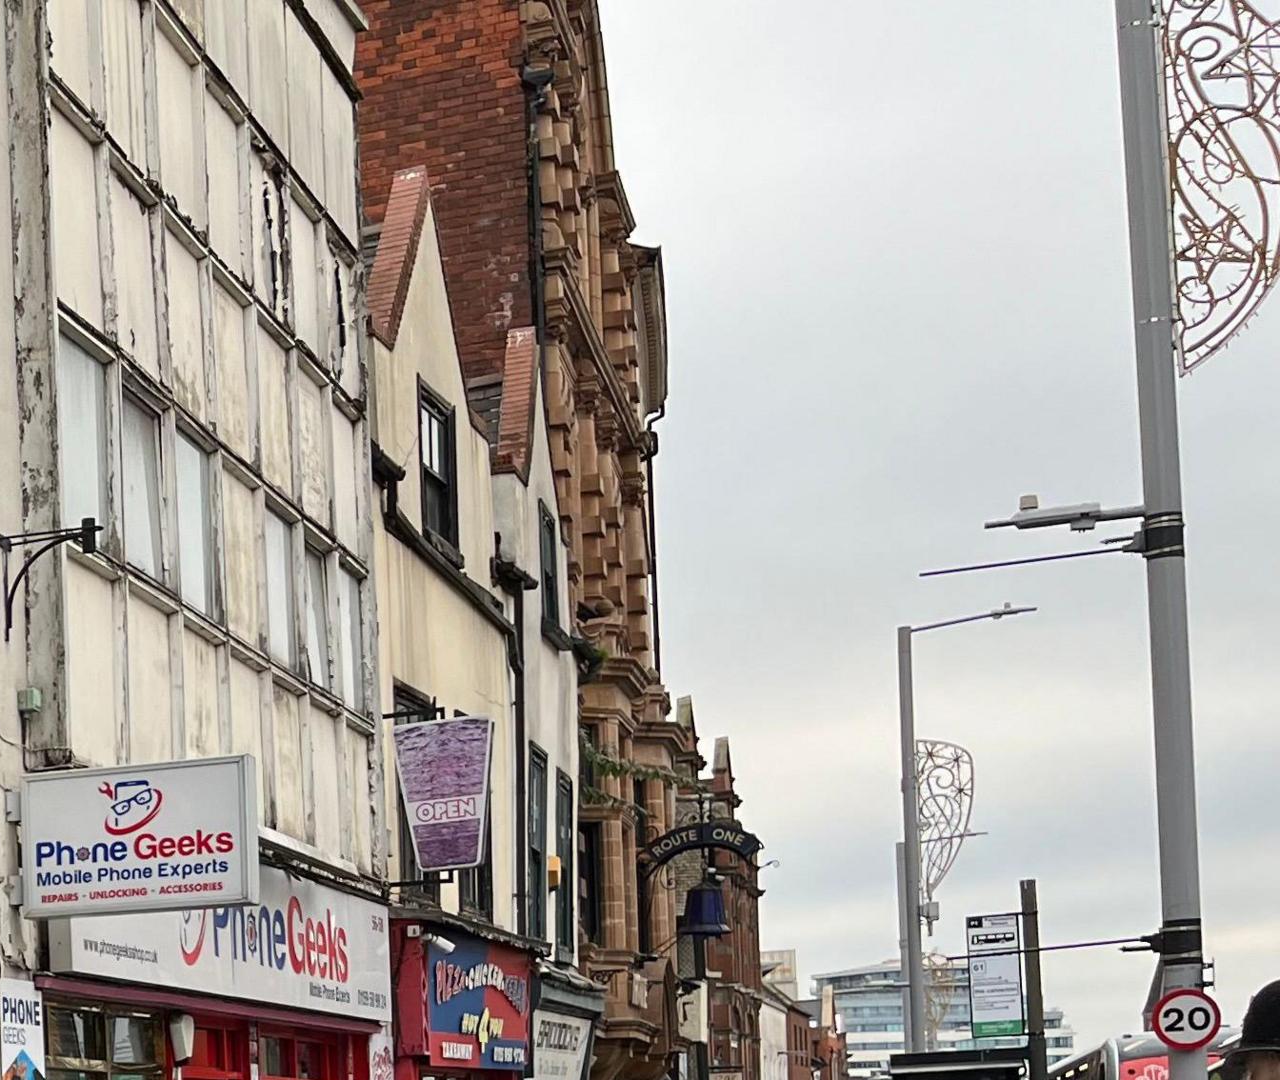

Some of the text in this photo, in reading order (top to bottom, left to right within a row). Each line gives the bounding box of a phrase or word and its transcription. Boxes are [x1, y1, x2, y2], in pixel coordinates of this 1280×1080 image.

[416, 798, 476, 822] OPEN
[133, 829, 234, 860] Geeks
[651, 828, 745, 857] ROUTE ONE
[37, 858, 229, 887] Mobile Phone Experts
[41, 882, 224, 904] REPAIRS UNLOCKING ACCESSORIES
[288, 895, 349, 983] Geeks
[436, 960, 466, 1005] PIZZA
[468, 963, 504, 991] CHICKEN
[2, 996, 40, 1026] PHONE
[1162, 1006, 1212, 1033] 20
[3, 1026, 26, 1045] GEEKS
